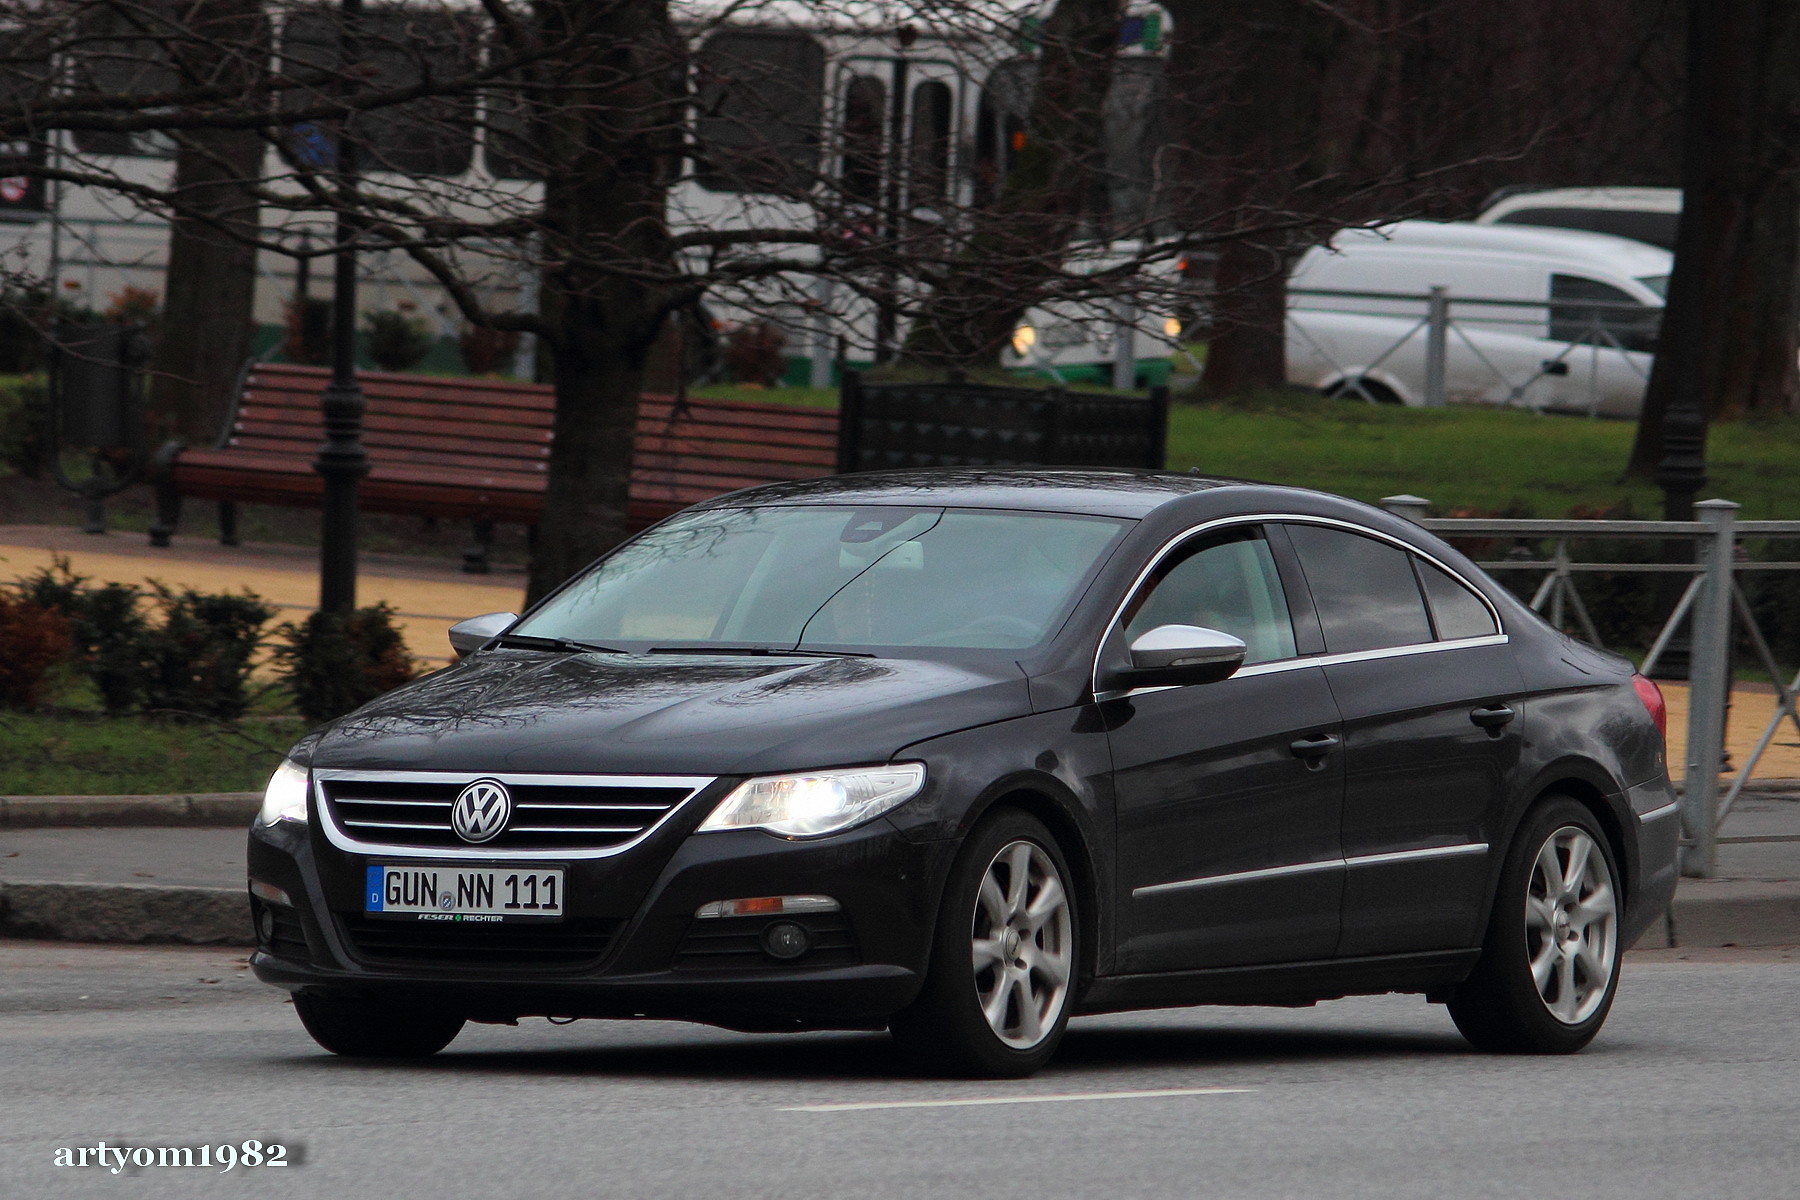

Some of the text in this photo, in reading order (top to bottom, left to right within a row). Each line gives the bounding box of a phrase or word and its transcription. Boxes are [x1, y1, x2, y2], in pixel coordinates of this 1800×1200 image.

[455, 783, 507, 839] VW
[371, 871, 559, 910] D GUN NN 111
[462, 914, 504, 922] RECHTER
